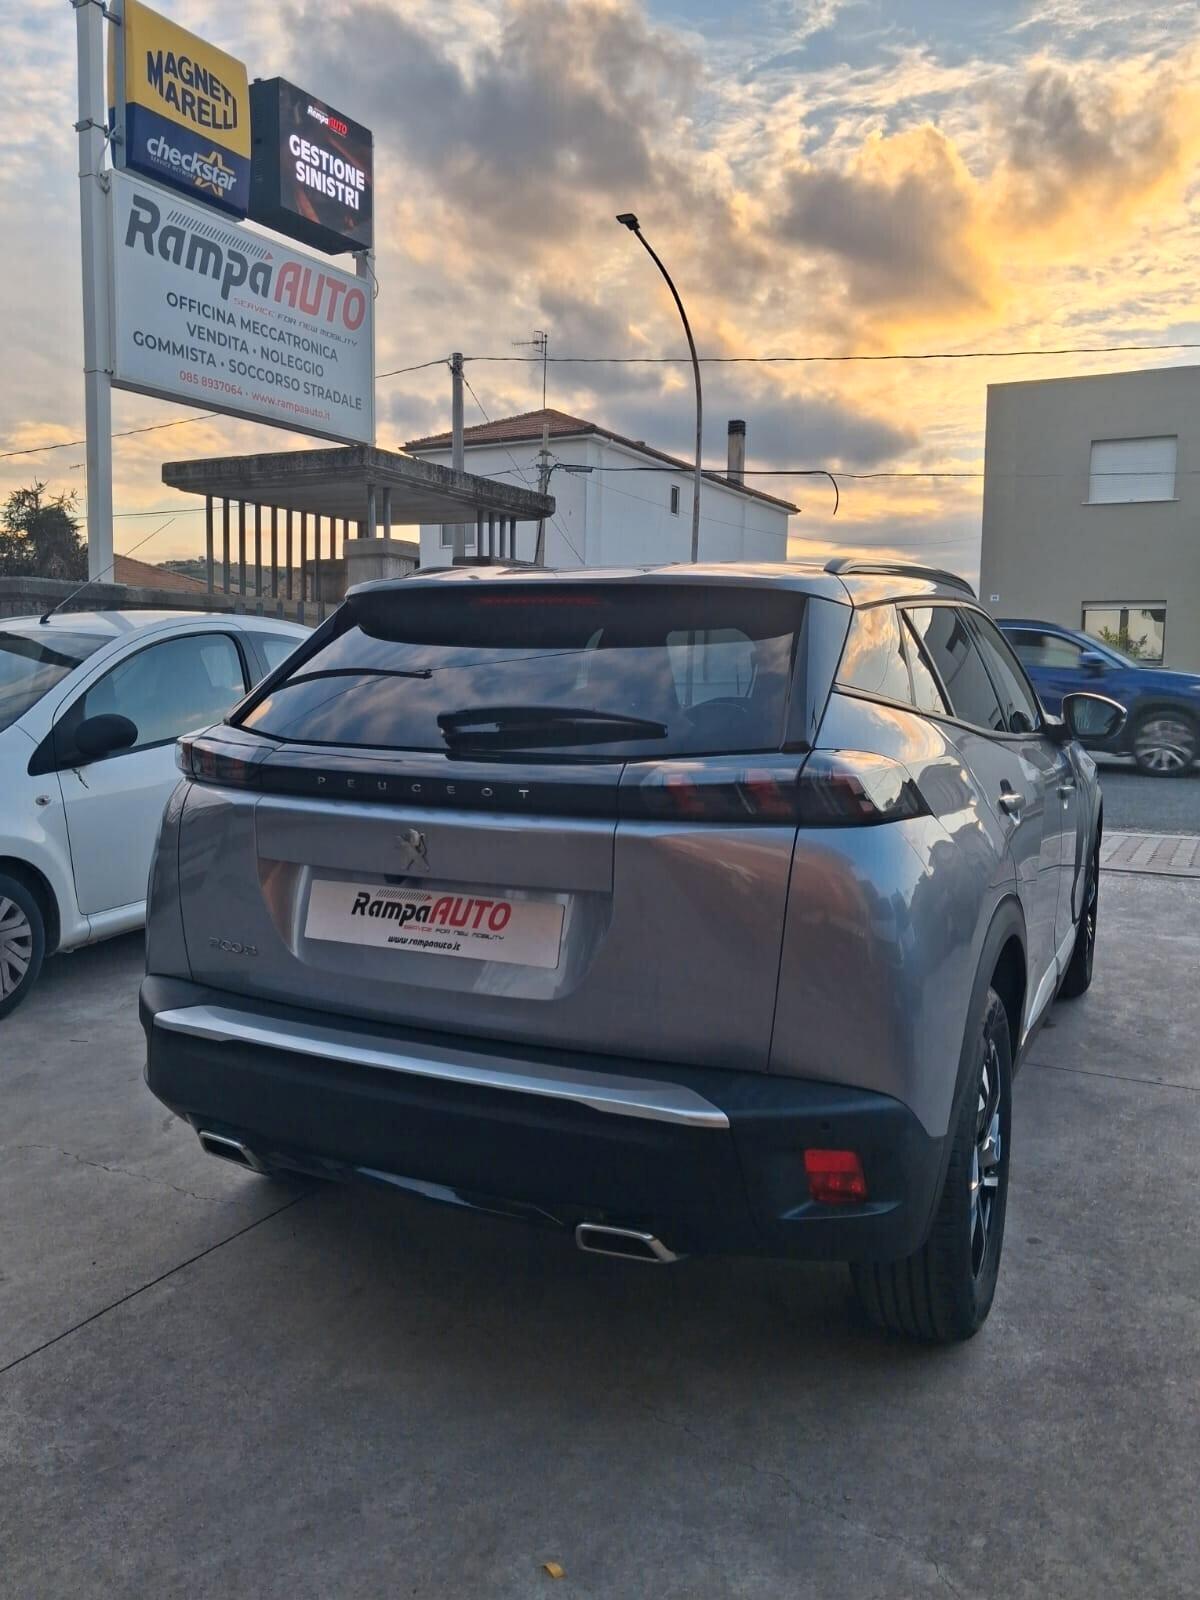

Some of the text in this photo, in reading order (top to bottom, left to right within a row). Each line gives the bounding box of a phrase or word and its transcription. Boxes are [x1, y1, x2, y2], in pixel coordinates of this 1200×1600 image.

[147, 50, 237, 108] MAGNETI
[147, 78, 237, 129] MARELLI
[147, 136, 237, 191] checkstar
[289, 134, 365, 192] GESTIONE
[295, 161, 359, 210] SINISTRI
[125, 194, 366, 331] RampaAUTO
[166, 291, 339, 362] OFFICINA MECCATRONICA
[186, 321, 324, 377] VENDITA NOLEGGIO
[133, 330, 362, 411] GOMMISTA SOCCORSO STRADALE
[179, 370, 330, 420] 085 8937064 www.rampaauto.it
[317, 775, 530, 799] PEUGEOT
[351, 891, 513, 931] RampaAUTO
